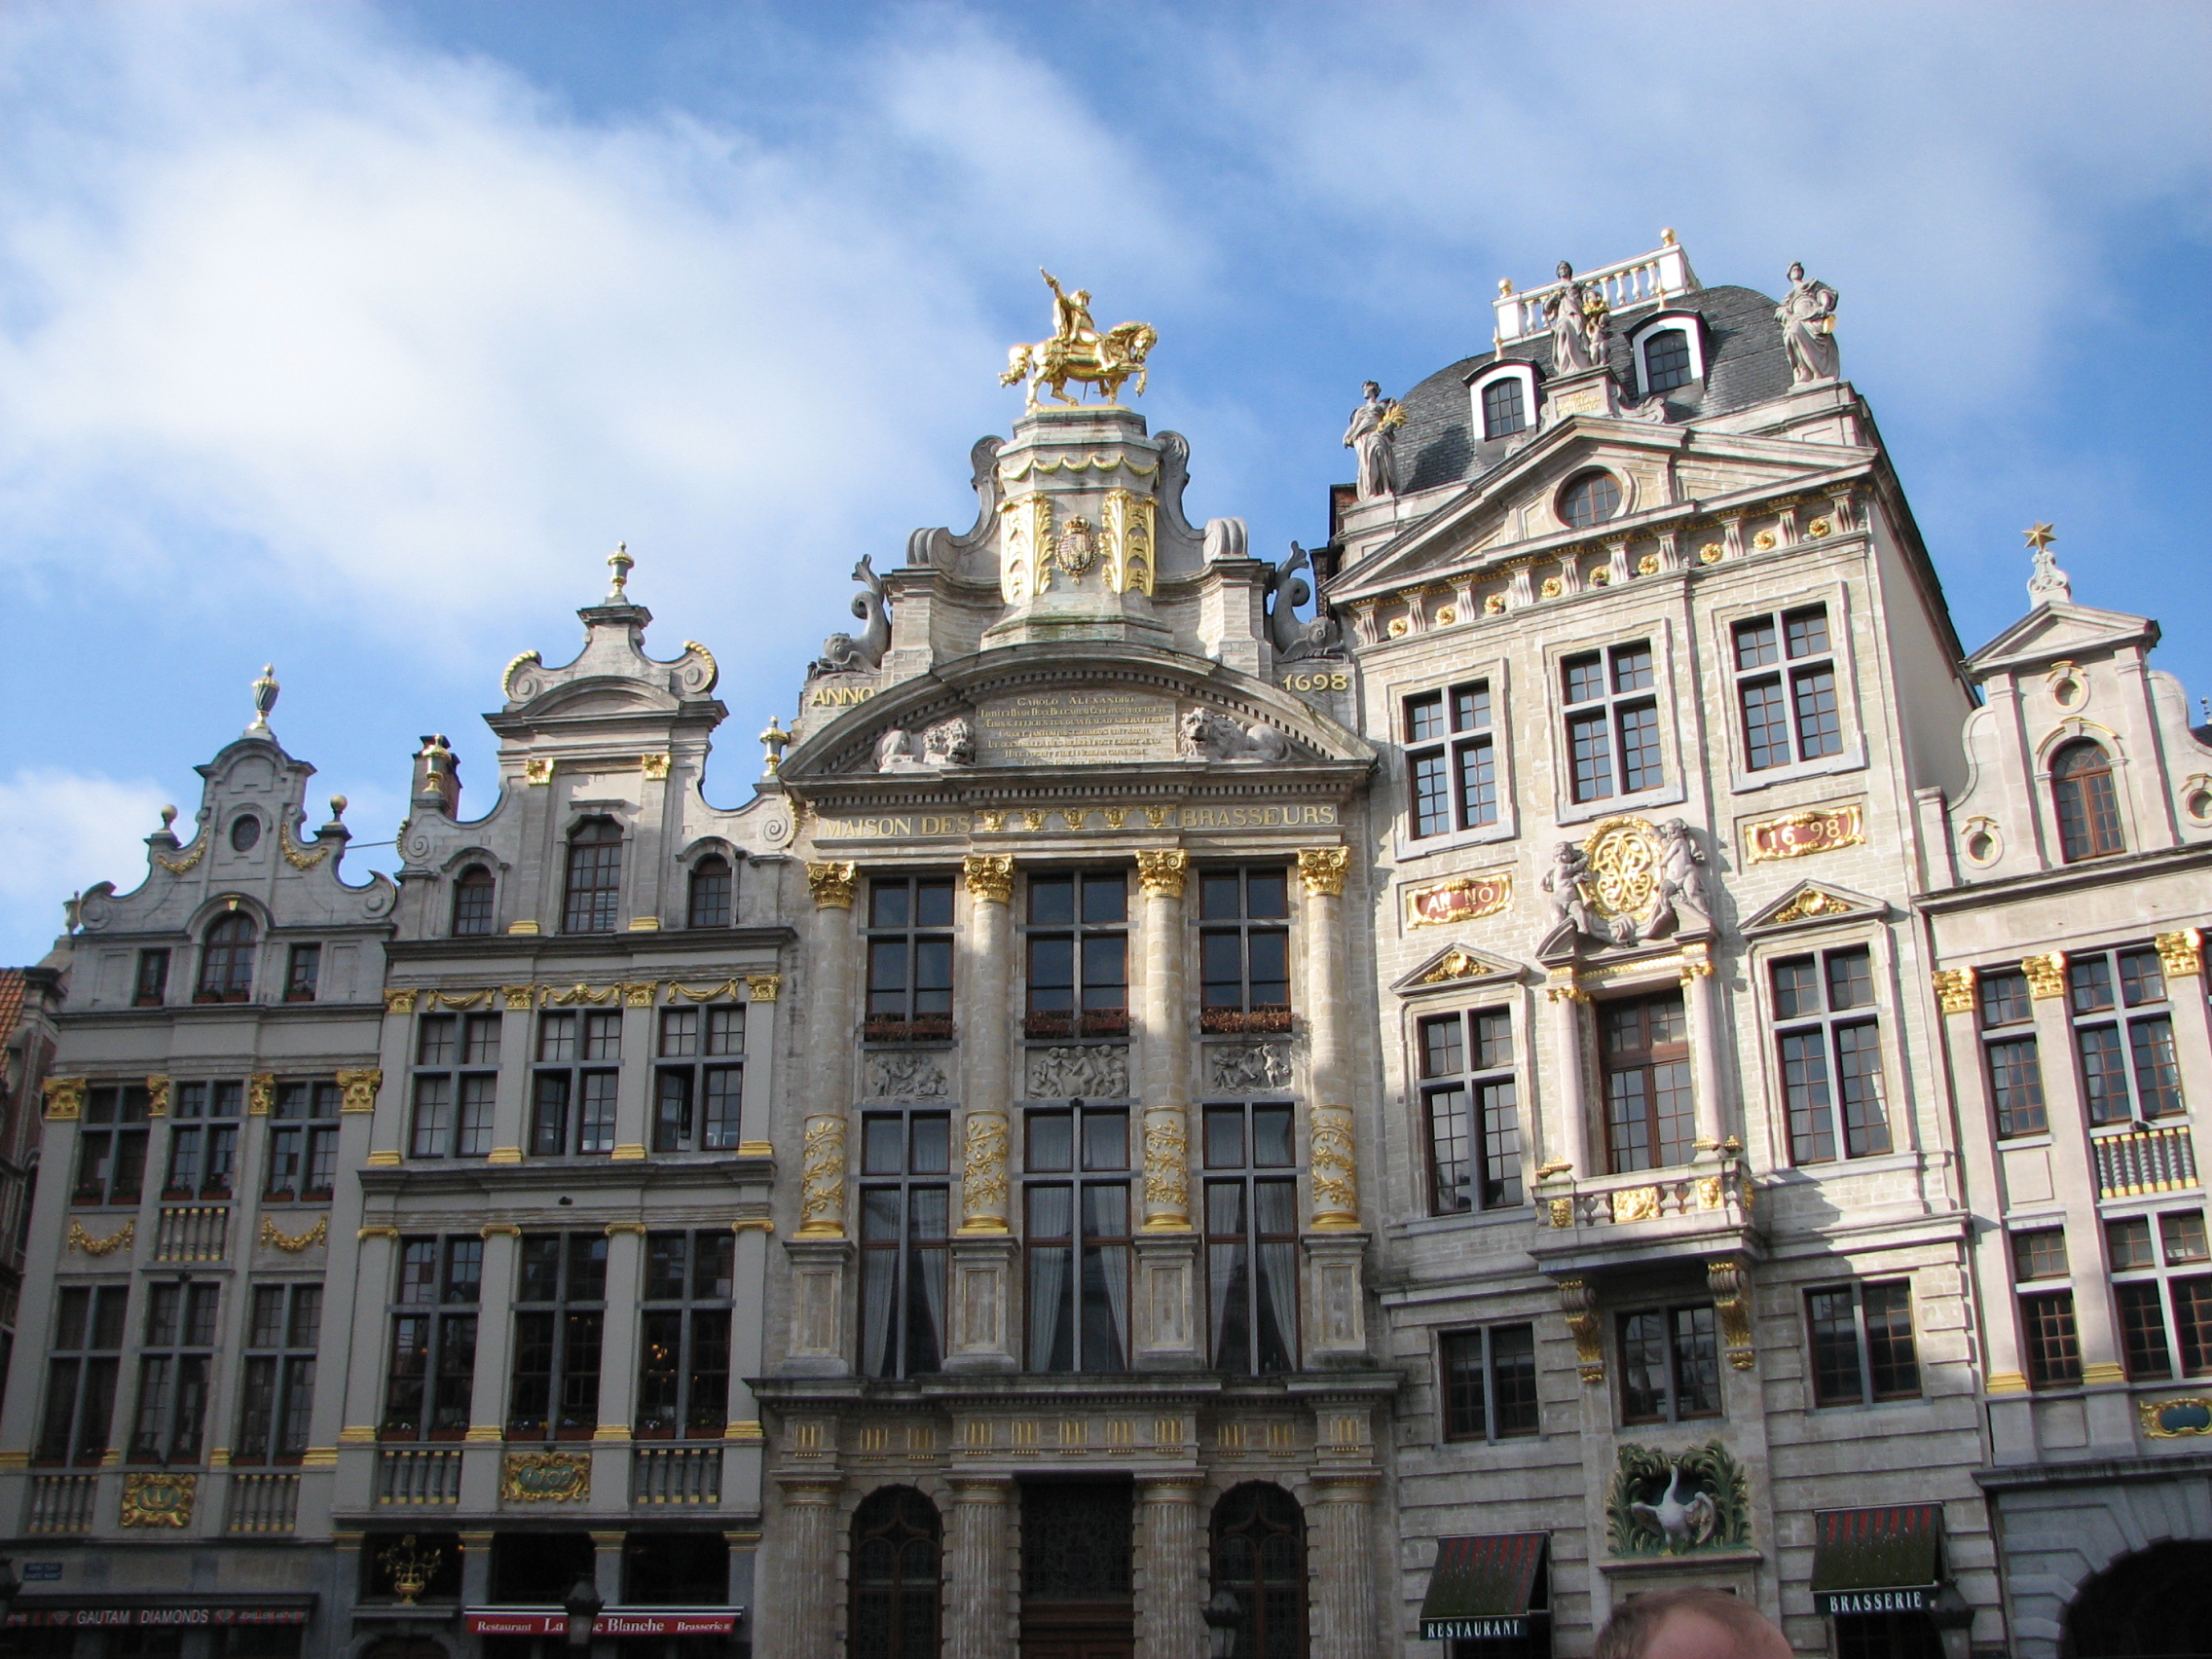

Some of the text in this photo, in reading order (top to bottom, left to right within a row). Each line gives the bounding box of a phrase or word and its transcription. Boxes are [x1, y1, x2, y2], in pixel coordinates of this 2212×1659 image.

[1282, 674, 1347, 691] 1698
[811, 686, 875, 705] ANNO
[1181, 806, 1335, 827] BRASSEURS
[826, 816, 973, 837] MAISON DES
[1829, 1592, 1922, 1613] BRASSERIE
[77, 1609, 130, 1624] GAUTAM
[140, 1609, 209, 1624] DIAMONDS
[477, 1618, 565, 1632] Restaurant La
[608, 1617, 665, 1632] Blanche
[677, 1620, 723, 1632] Brasserie
[1427, 1619, 1520, 1638] RESTAURANT
